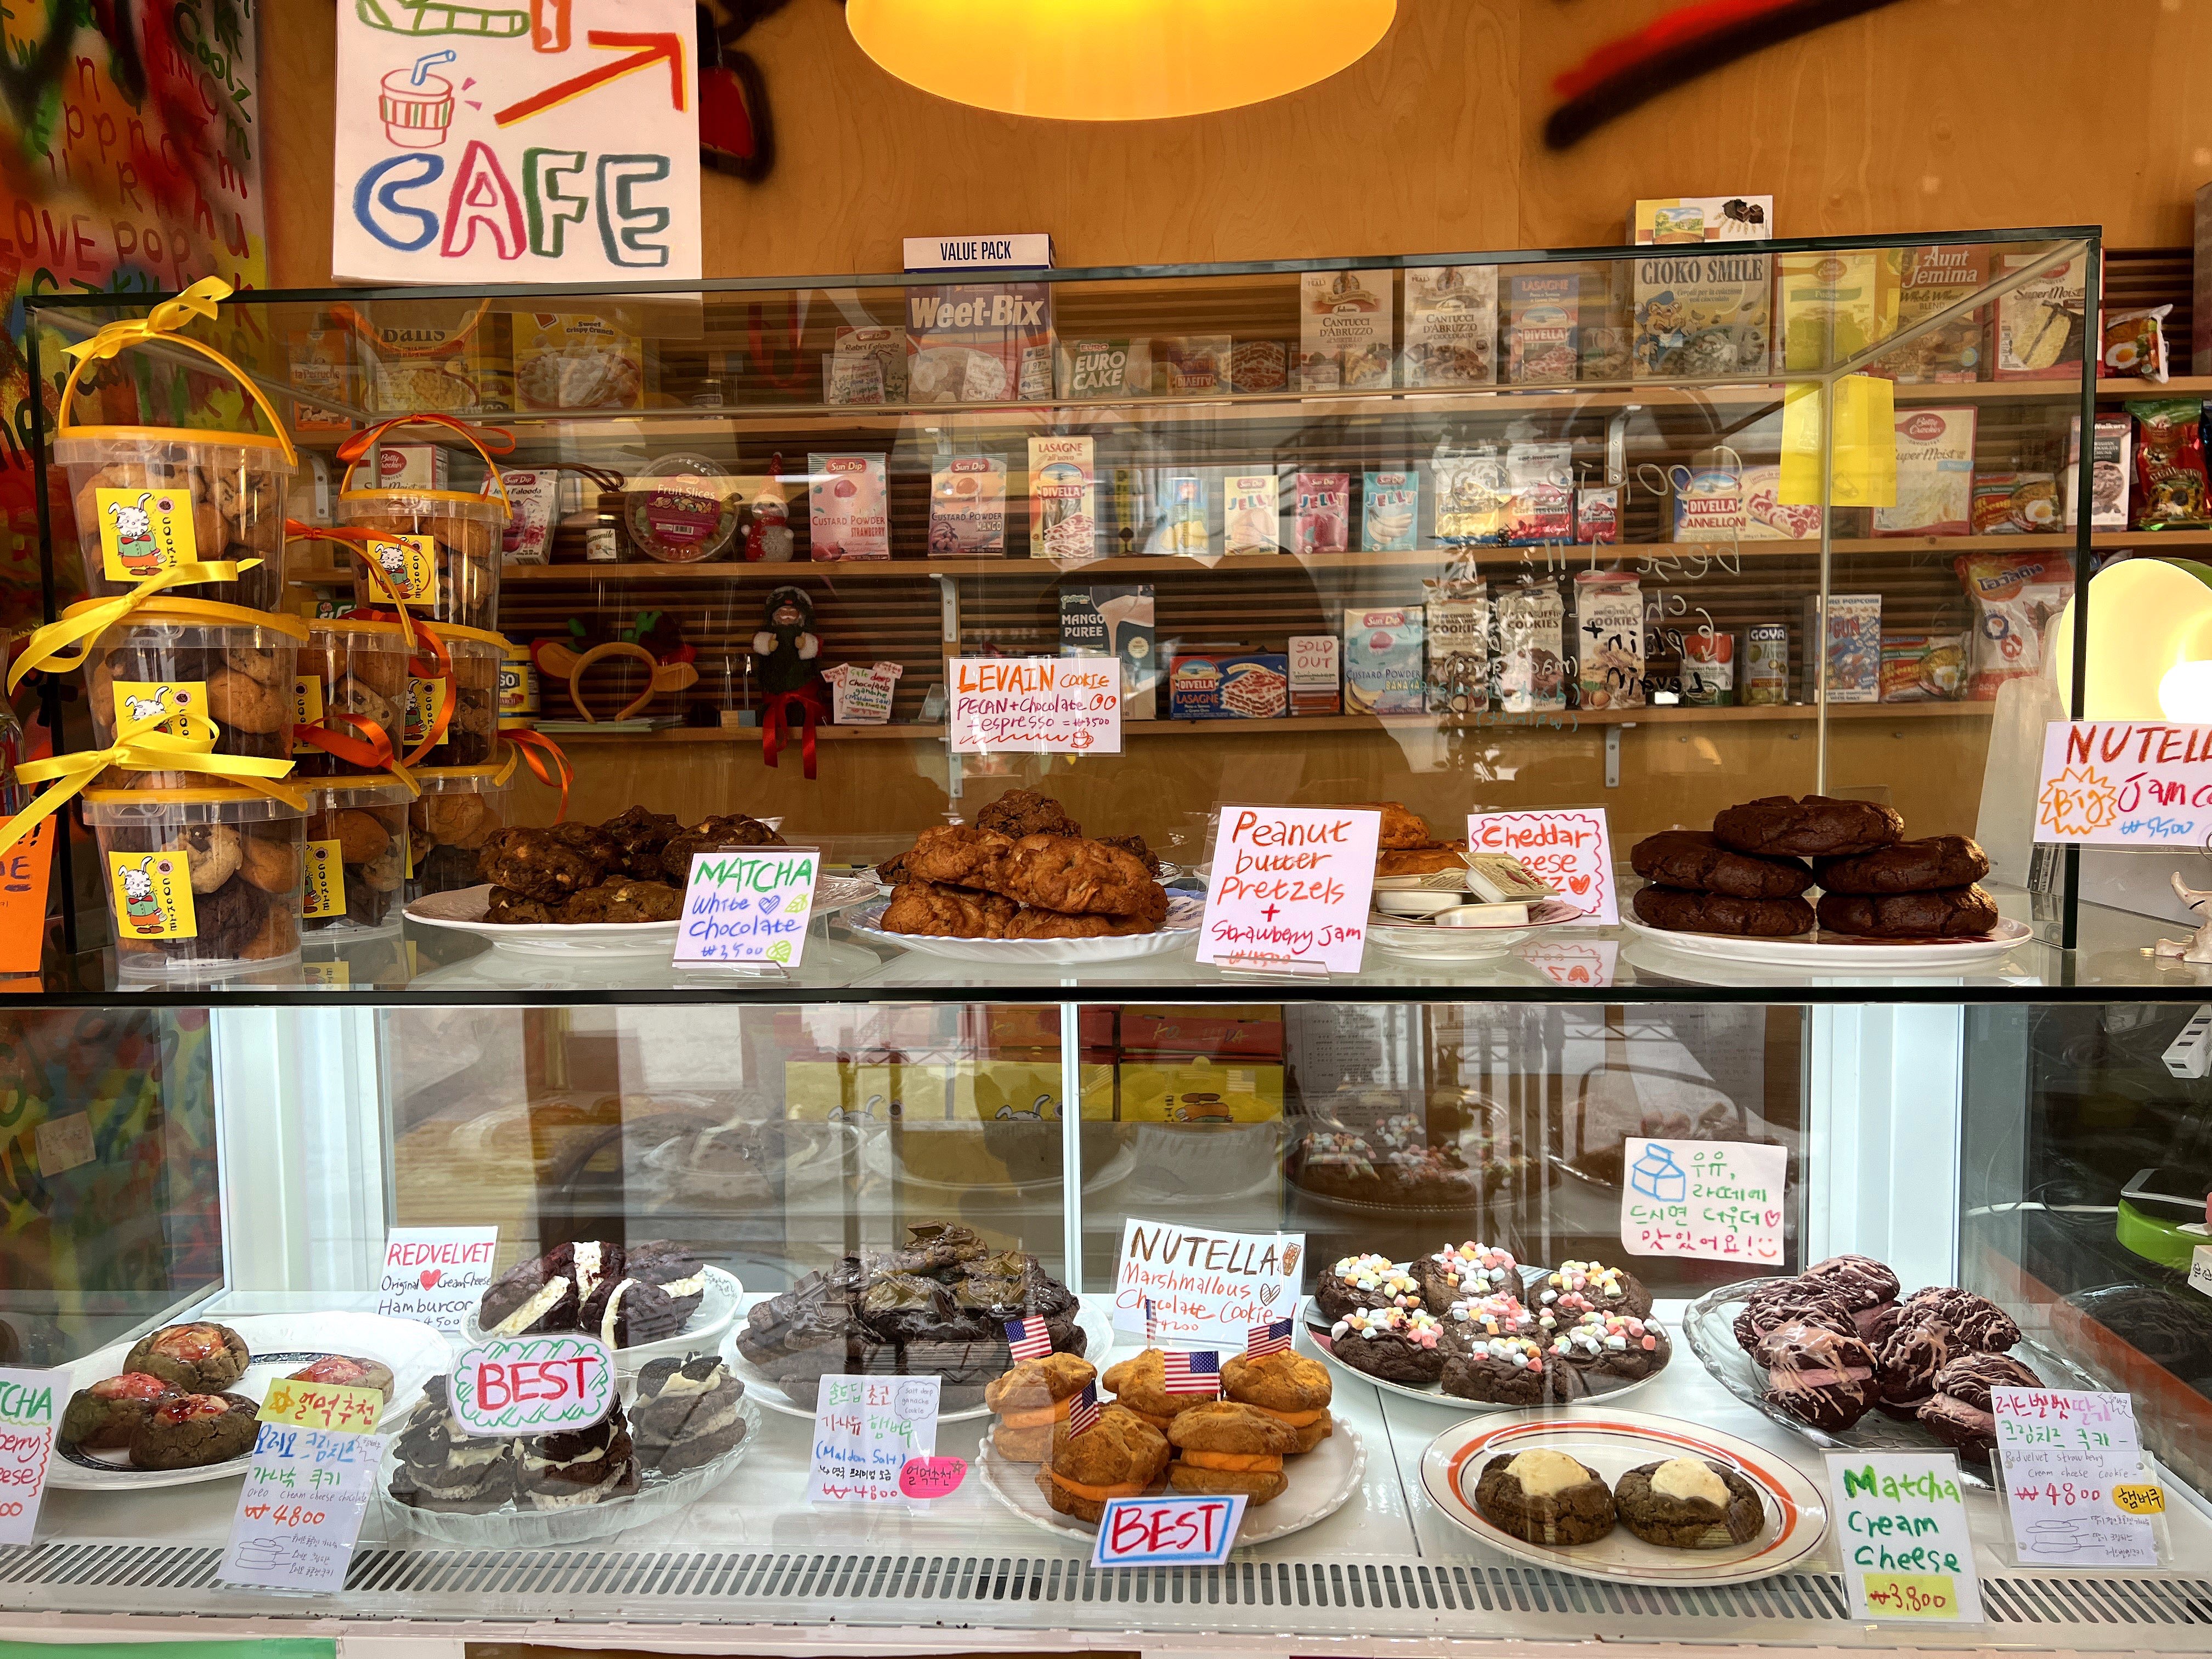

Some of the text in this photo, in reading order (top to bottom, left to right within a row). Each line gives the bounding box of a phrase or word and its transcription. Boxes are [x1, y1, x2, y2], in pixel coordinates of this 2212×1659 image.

[353, 139, 670, 268] CAFE
[940, 240, 1012, 261] VALUE PACK
[1924, 246, 1970, 267] Aunt
[1640, 257, 1763, 285] CIOKO SMILE
[1902, 264, 1978, 289] Jemima
[911, 294, 1043, 329] Weet-Bix
[1426, 313, 1474, 324] CANTUCCI
[1319, 327, 1373, 337] D'ABRUZZO
[1323, 317, 1370, 328] CANTUCCI
[1423, 324, 1477, 334] D'ABRUZZO
[1524, 329, 1564, 341] DIVELLA
[1076, 351, 1125, 373] EURO
[1073, 370, 1122, 390] CAKE
[1039, 442, 1082, 454] LASAGNE
[831, 461, 862, 471] Sun Dip
[955, 462, 985, 471] Sun Dip
[658, 484, 715, 500] Fruit Slices
[1041, 486, 1081, 498] DIVELLA
[1299, 493, 1347, 510] JELLY
[1366, 490, 1417, 508] JELLY
[1227, 494, 1276, 511] JELLY
[1689, 499, 1736, 514] DIVELLA
[812, 515, 885, 526] CUSTARD POWDER
[931, 512, 1002, 521] CUSTARD POWDER
[1679, 516, 1747, 528] CANNELLONI
[851, 527, 885, 537] STRAWBERRY
[976, 521, 1002, 532] MANGO
[161, 516, 177, 567] COOKI
[1062, 614, 1105, 625] MANGO
[1367, 615, 1402, 627] Sun Dip
[1064, 627, 1103, 637] PUREE
[1295, 640, 1333, 654] SOLD
[1297, 656, 1333, 669] OUT
[956, 663, 1109, 695] LEVAIN COOKIE
[1346, 669, 1383, 681] CUSTARD
[1385, 669, 1421, 680] POWDER
[1180, 680, 1214, 690] DIVELLA
[1176, 694, 1219, 704] LASAGNE
[2053, 788, 2104, 824] Big
[1232, 810, 1352, 847] Peanut
[1481, 822, 1593, 849] Cheddar
[1235, 849, 1332, 875] butter
[693, 856, 813, 894] MATCHA
[318, 864, 330, 911] COOKIE
[162, 878, 177, 931] COOKIE
[1130, 1226, 1279, 1277] NUTELLA
[381, 1274, 420, 1296] Original
[1116, 1288, 1216, 1319] Chcolate
[477, 1356, 599, 1412] BEST
[253, 1424, 298, 1458] 오레오
[2061, 1468, 2089, 1478] cheese
[1842, 1464, 1961, 1504] Matcha
[2015, 1482, 2101, 1507] ₩4800
[244, 1503, 326, 1528] ₩4800
[1847, 1510, 1940, 1539] Cream
[1110, 1504, 1224, 1555] BEST
[1854, 1543, 1962, 1574] Cheese
